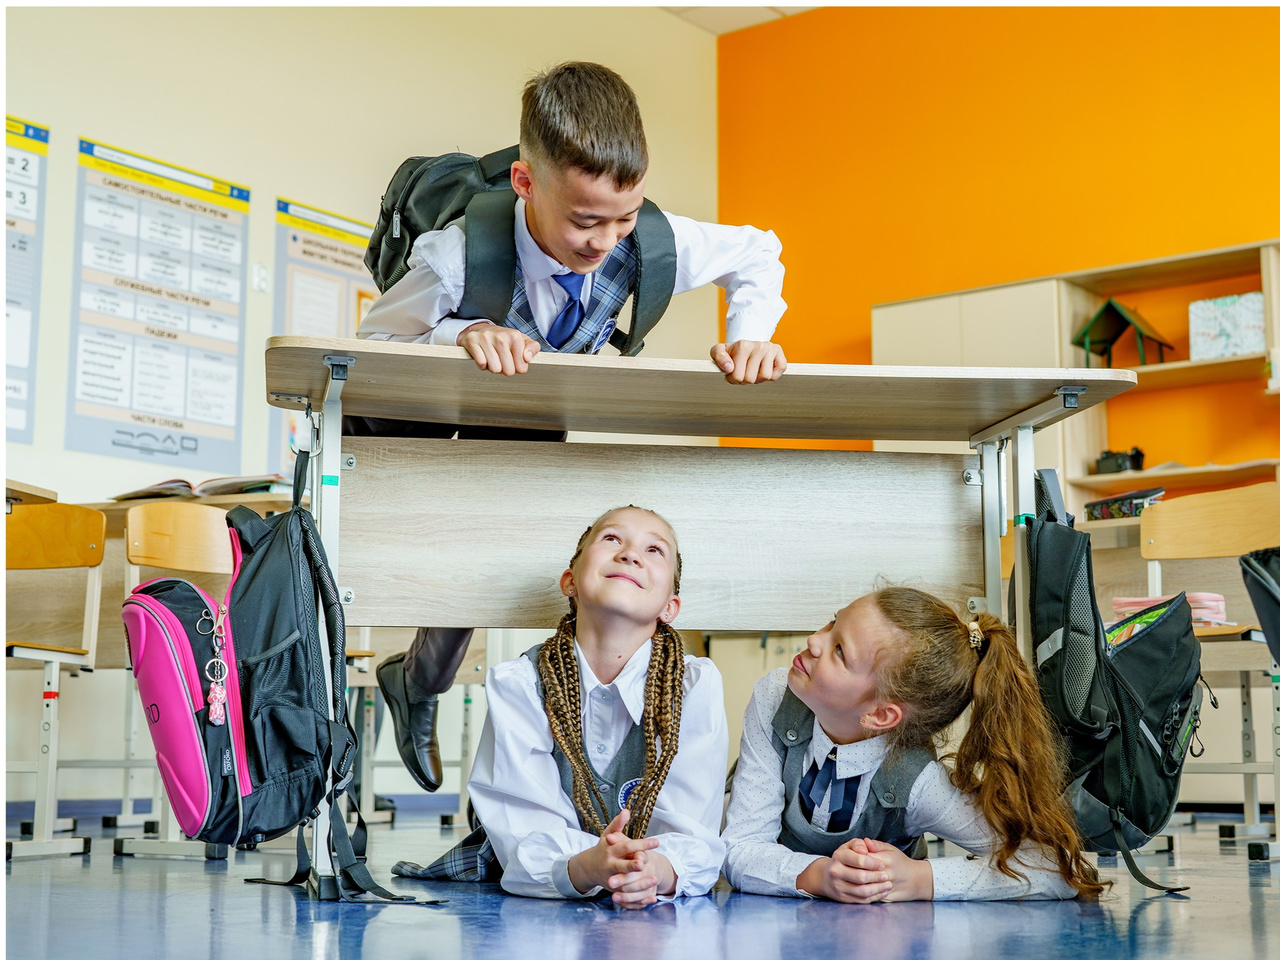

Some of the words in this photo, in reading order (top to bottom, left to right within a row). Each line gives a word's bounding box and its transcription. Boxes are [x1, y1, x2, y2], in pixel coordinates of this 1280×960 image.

[102, 177, 181, 206] САМОСТОЯТЕЛЬНЫЕ
[184, 201, 208, 214] ЧАСТИ
[113, 277, 163, 295] СЛУЖЕБНЫЕ
[166, 290, 189, 302] ЧАСТИ
[144, 326, 179, 340] ПАДЕЖИ
